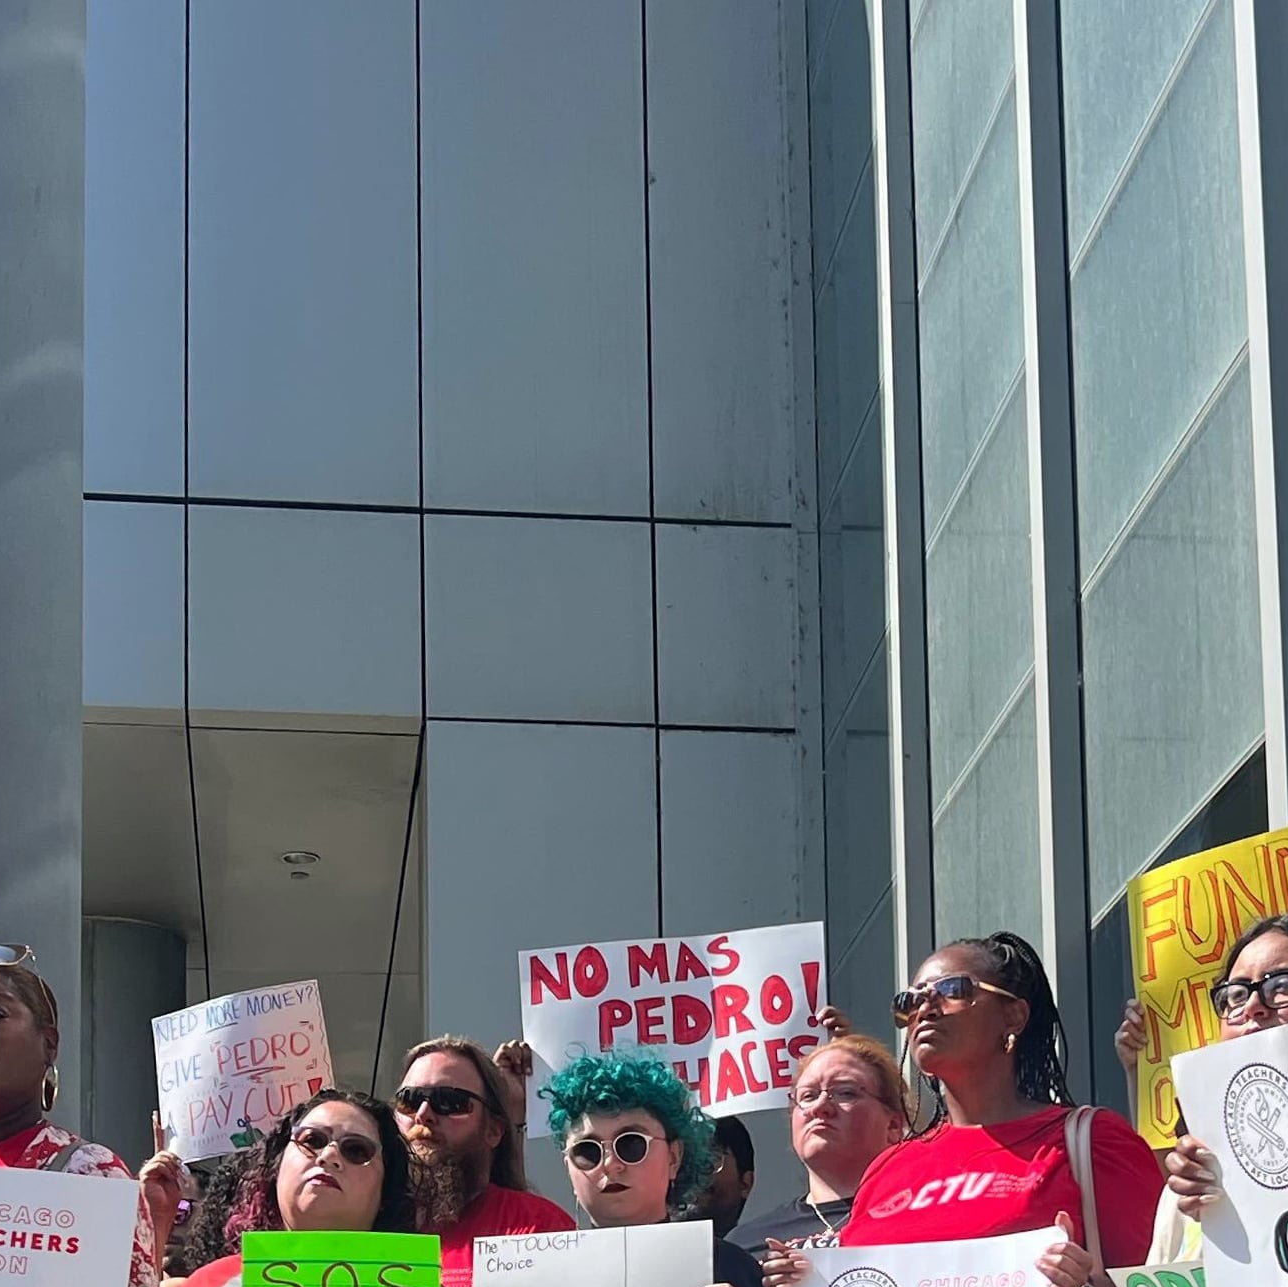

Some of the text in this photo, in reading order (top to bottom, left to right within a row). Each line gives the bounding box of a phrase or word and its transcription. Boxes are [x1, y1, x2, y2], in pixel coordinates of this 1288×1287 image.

[529, 935, 741, 1005] NO MAS
[155, 985, 314, 1044] NEED MORE MONEY?
[598, 961, 821, 1053] PEDRO!
[161, 1053, 203, 1093] GIVE
[1235, 1068, 1288, 1090] TEACHERS
[188, 1090, 234, 1137] PAY
[908, 1171, 997, 1211] CTU
[475, 1240, 499, 1256] The
[486, 1257, 535, 1272] Choice
